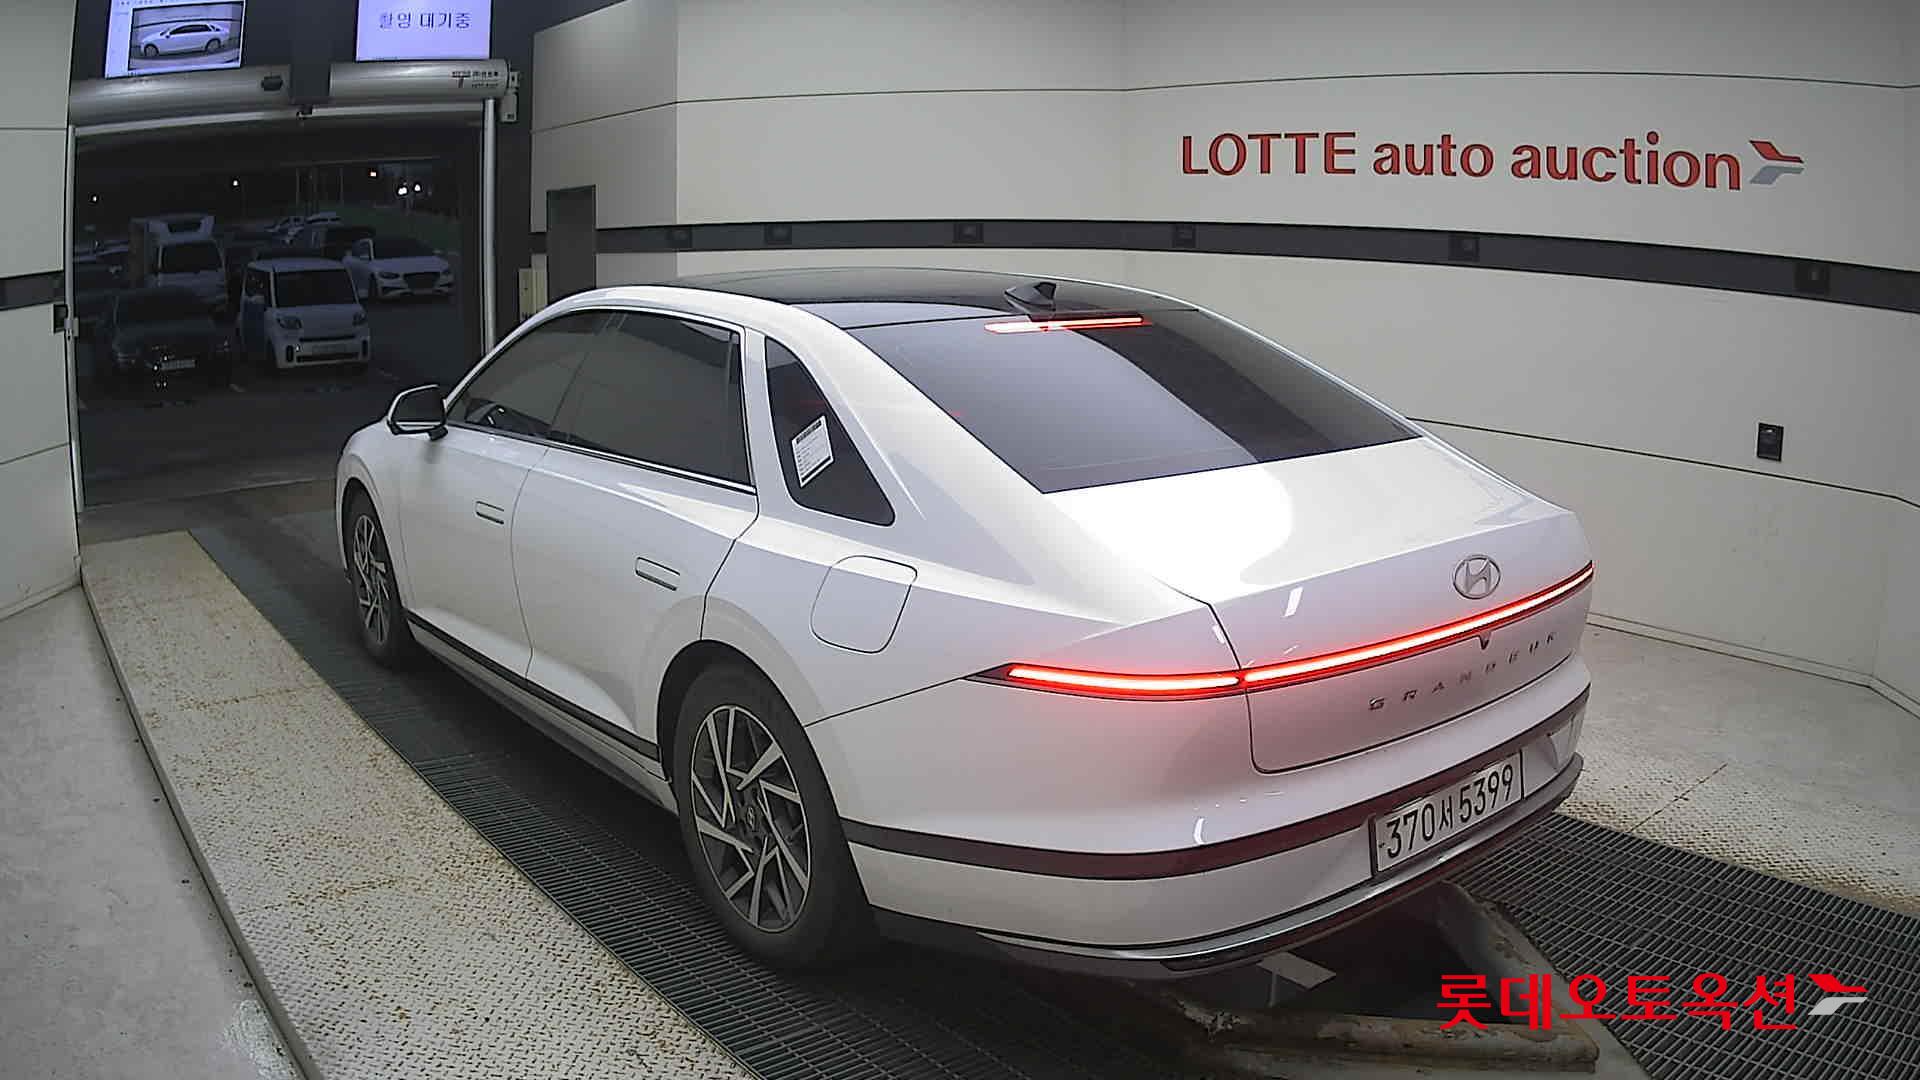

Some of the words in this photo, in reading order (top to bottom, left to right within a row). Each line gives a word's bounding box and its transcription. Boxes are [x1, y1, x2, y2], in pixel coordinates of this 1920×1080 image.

[419, 11, 472, 29] 대기중
[1183, 132, 1357, 175] LOTTE
[1372, 134, 1495, 178] auto
[1510, 131, 1742, 190] auction
